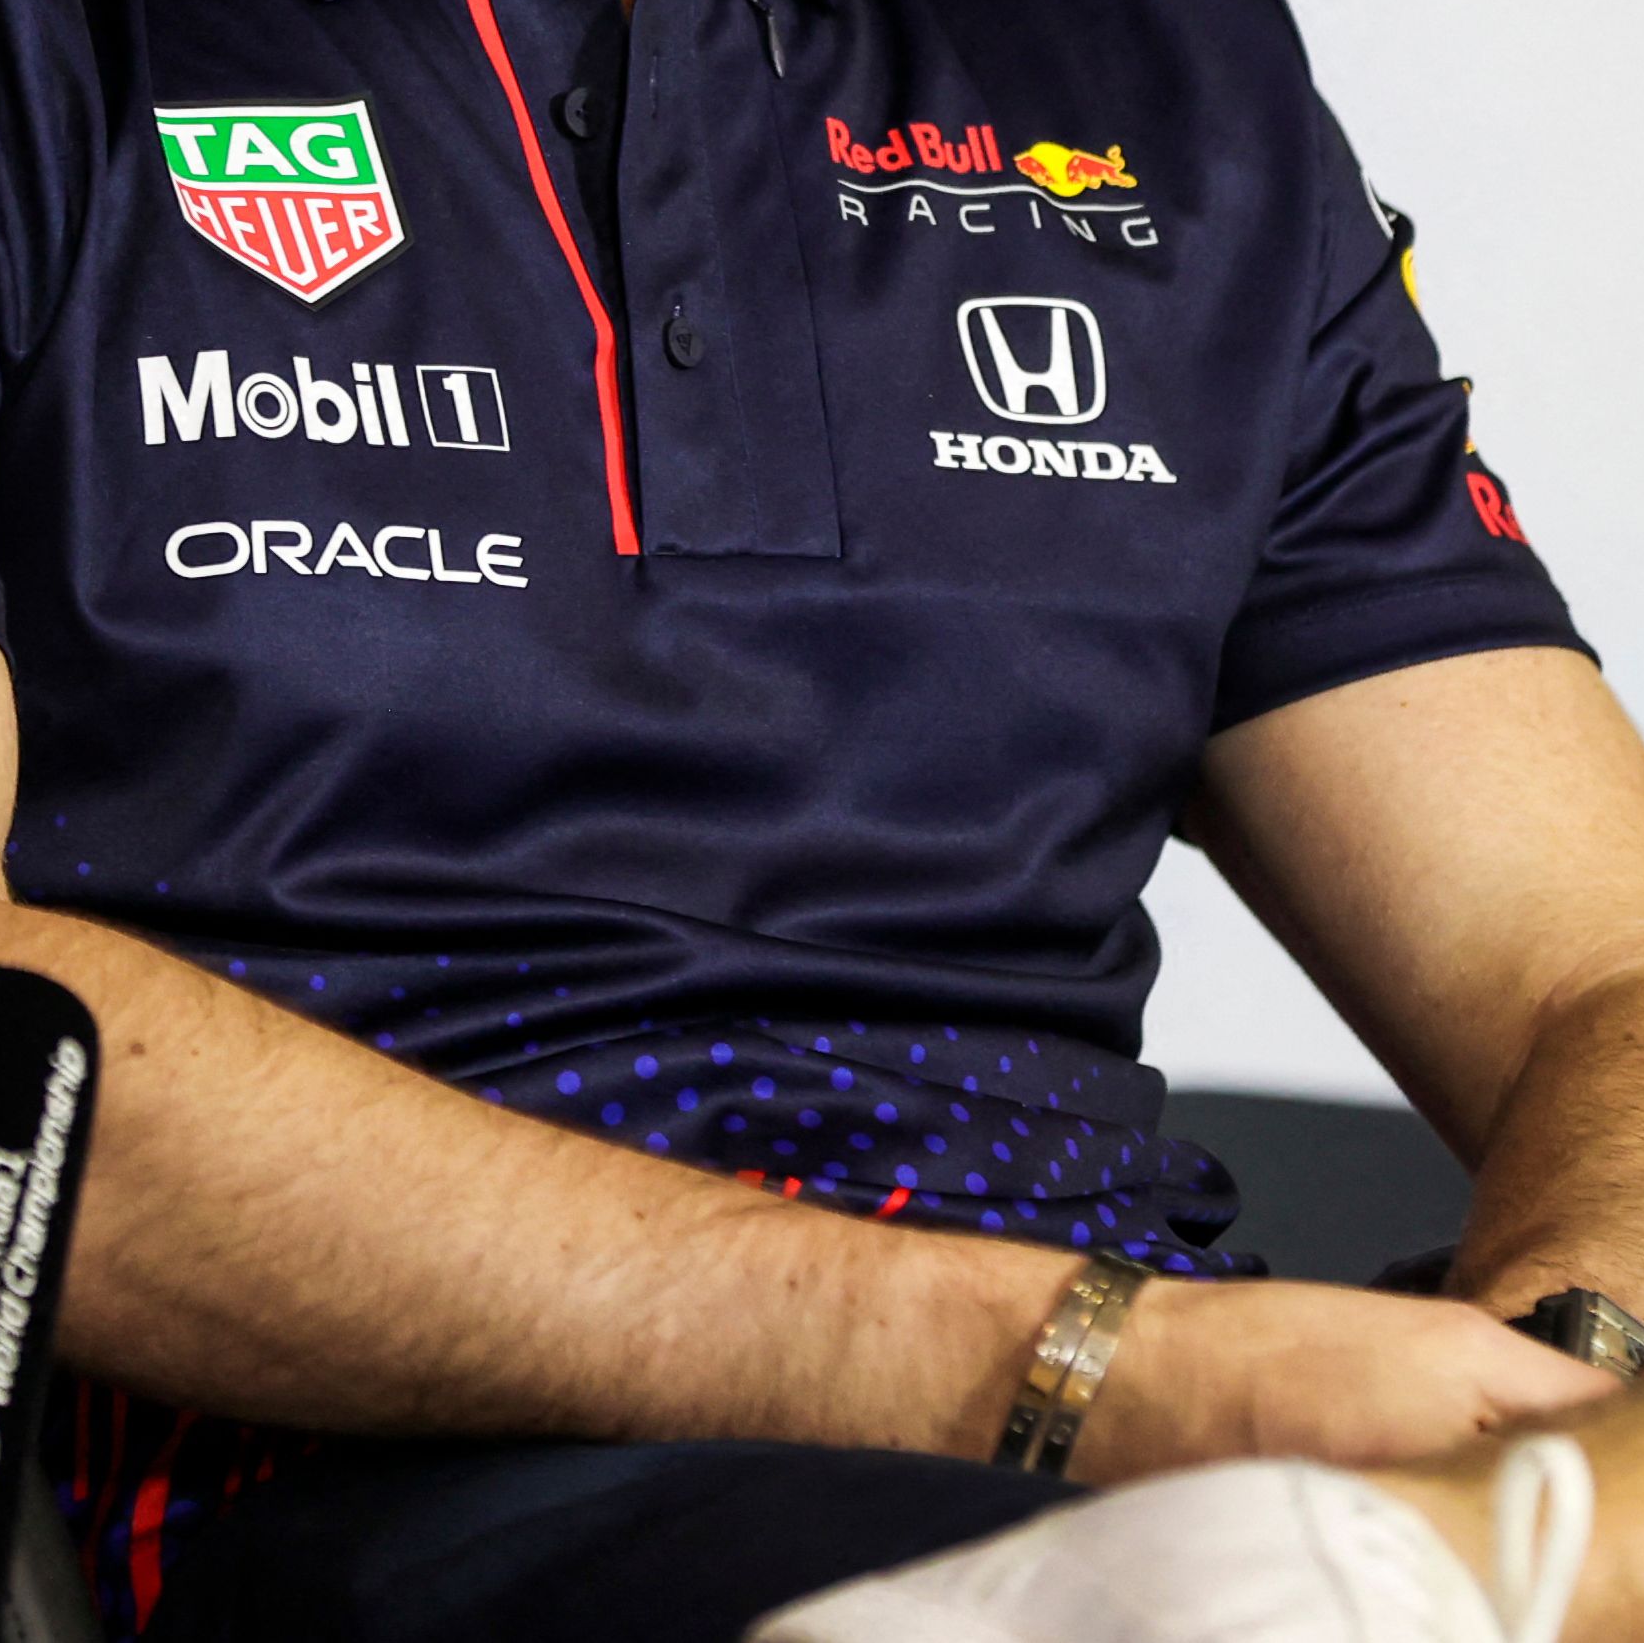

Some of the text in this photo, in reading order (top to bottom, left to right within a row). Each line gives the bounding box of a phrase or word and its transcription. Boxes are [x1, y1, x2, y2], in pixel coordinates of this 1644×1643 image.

[160, 121, 359, 180] TAG
[826, 116, 1003, 174] Red Bull
[180, 187, 385, 286] HEUER
[838, 192, 1158, 248] RACING
[137, 350, 480, 447] Mobil 1
[929, 430, 1177, 484] HONDA
[165, 520, 529, 589] ORACLE
[0, 1035, 87, 1299] Championship
